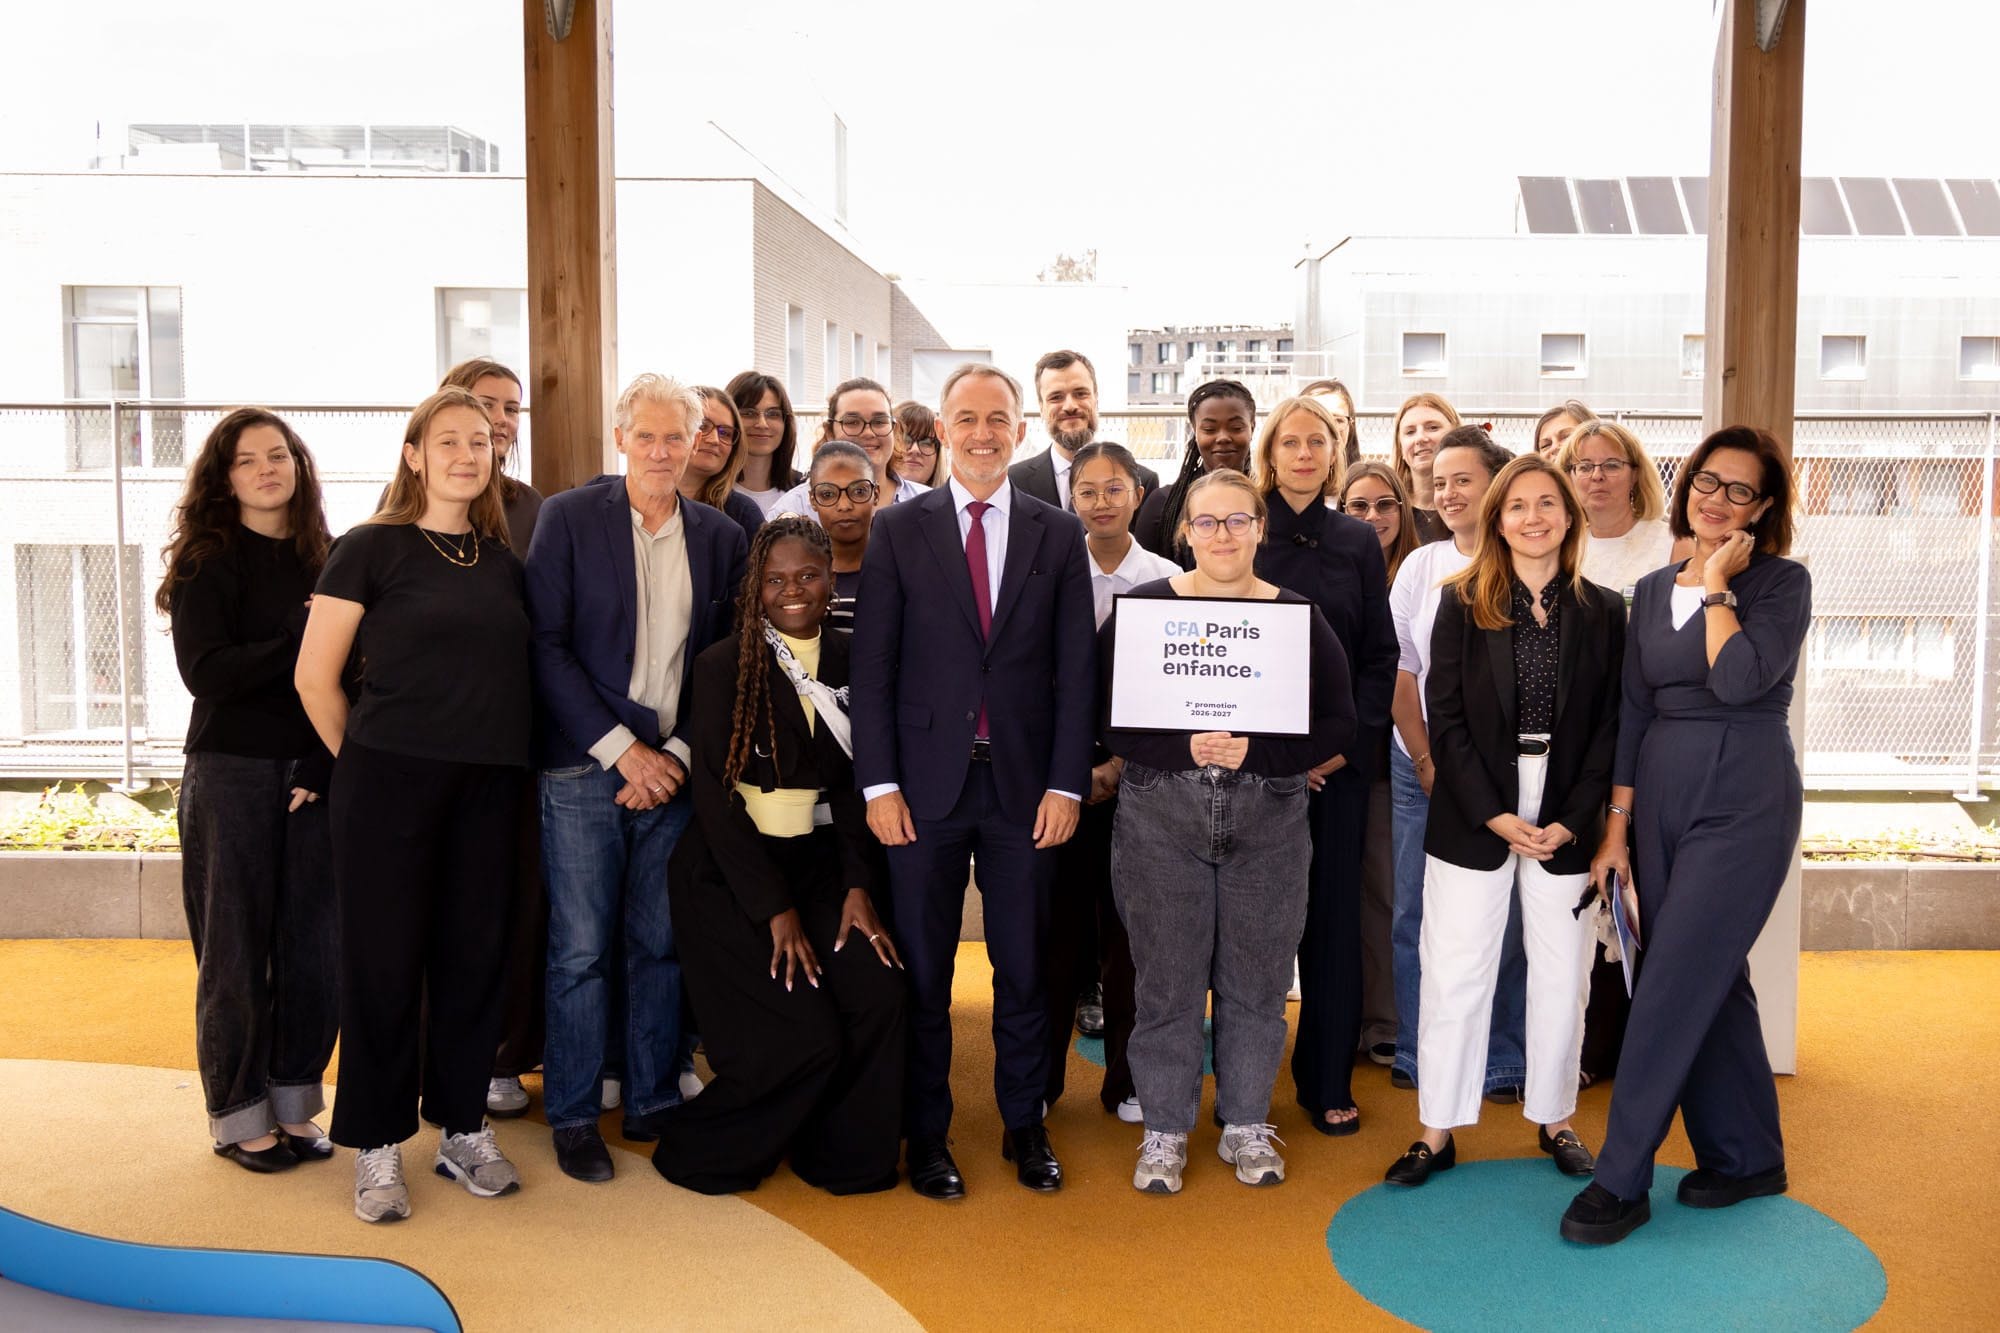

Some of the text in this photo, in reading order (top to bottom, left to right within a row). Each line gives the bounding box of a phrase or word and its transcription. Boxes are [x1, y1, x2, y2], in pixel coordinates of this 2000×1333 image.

[1164, 619, 1260, 639] CFA Paris
[1164, 638, 1227, 659] petite
[1190, 709, 1231, 717] 2026-2027
[1194, 702, 1237, 710] promotion
